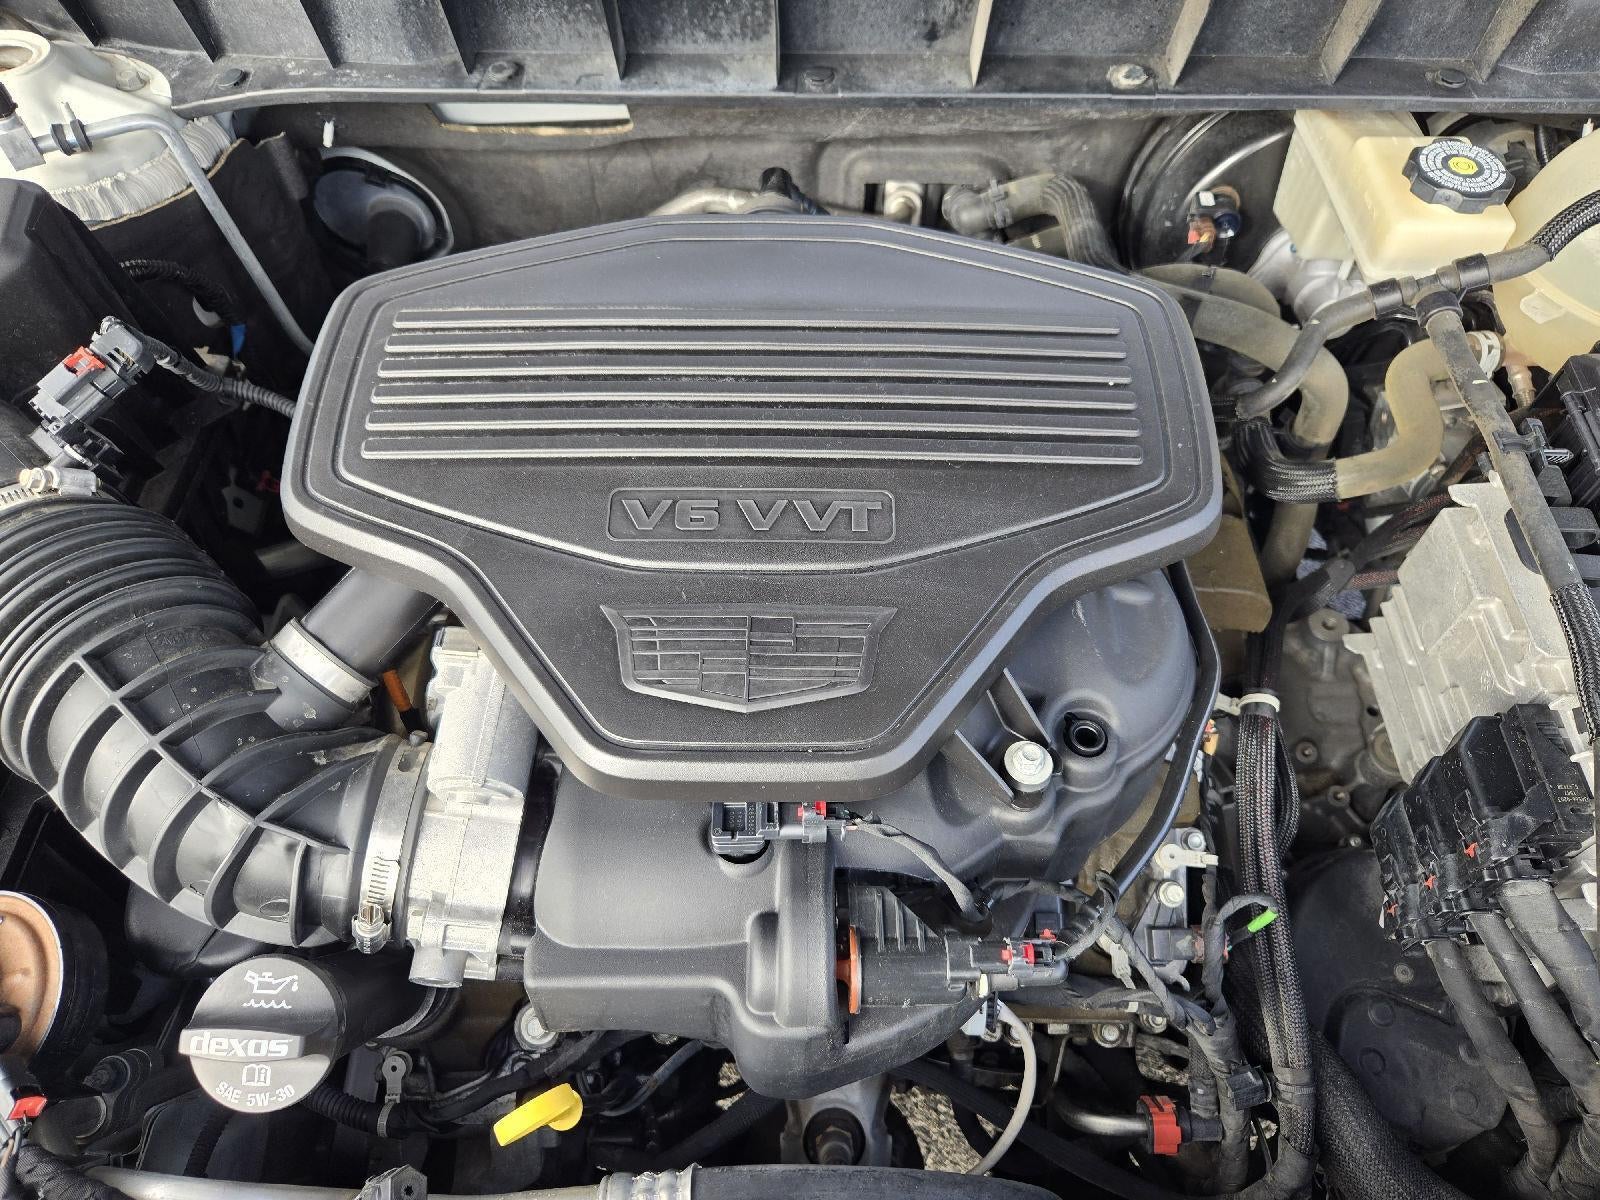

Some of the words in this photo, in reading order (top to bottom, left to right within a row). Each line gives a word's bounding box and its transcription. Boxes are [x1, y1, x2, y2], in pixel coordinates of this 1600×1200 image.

[621, 498, 720, 531] V6
[736, 498, 883, 532] VVT
[189, 1031, 290, 1057] dexos
[215, 1080, 241, 1104] SAE
[247, 1084, 296, 1107] 5W-30
